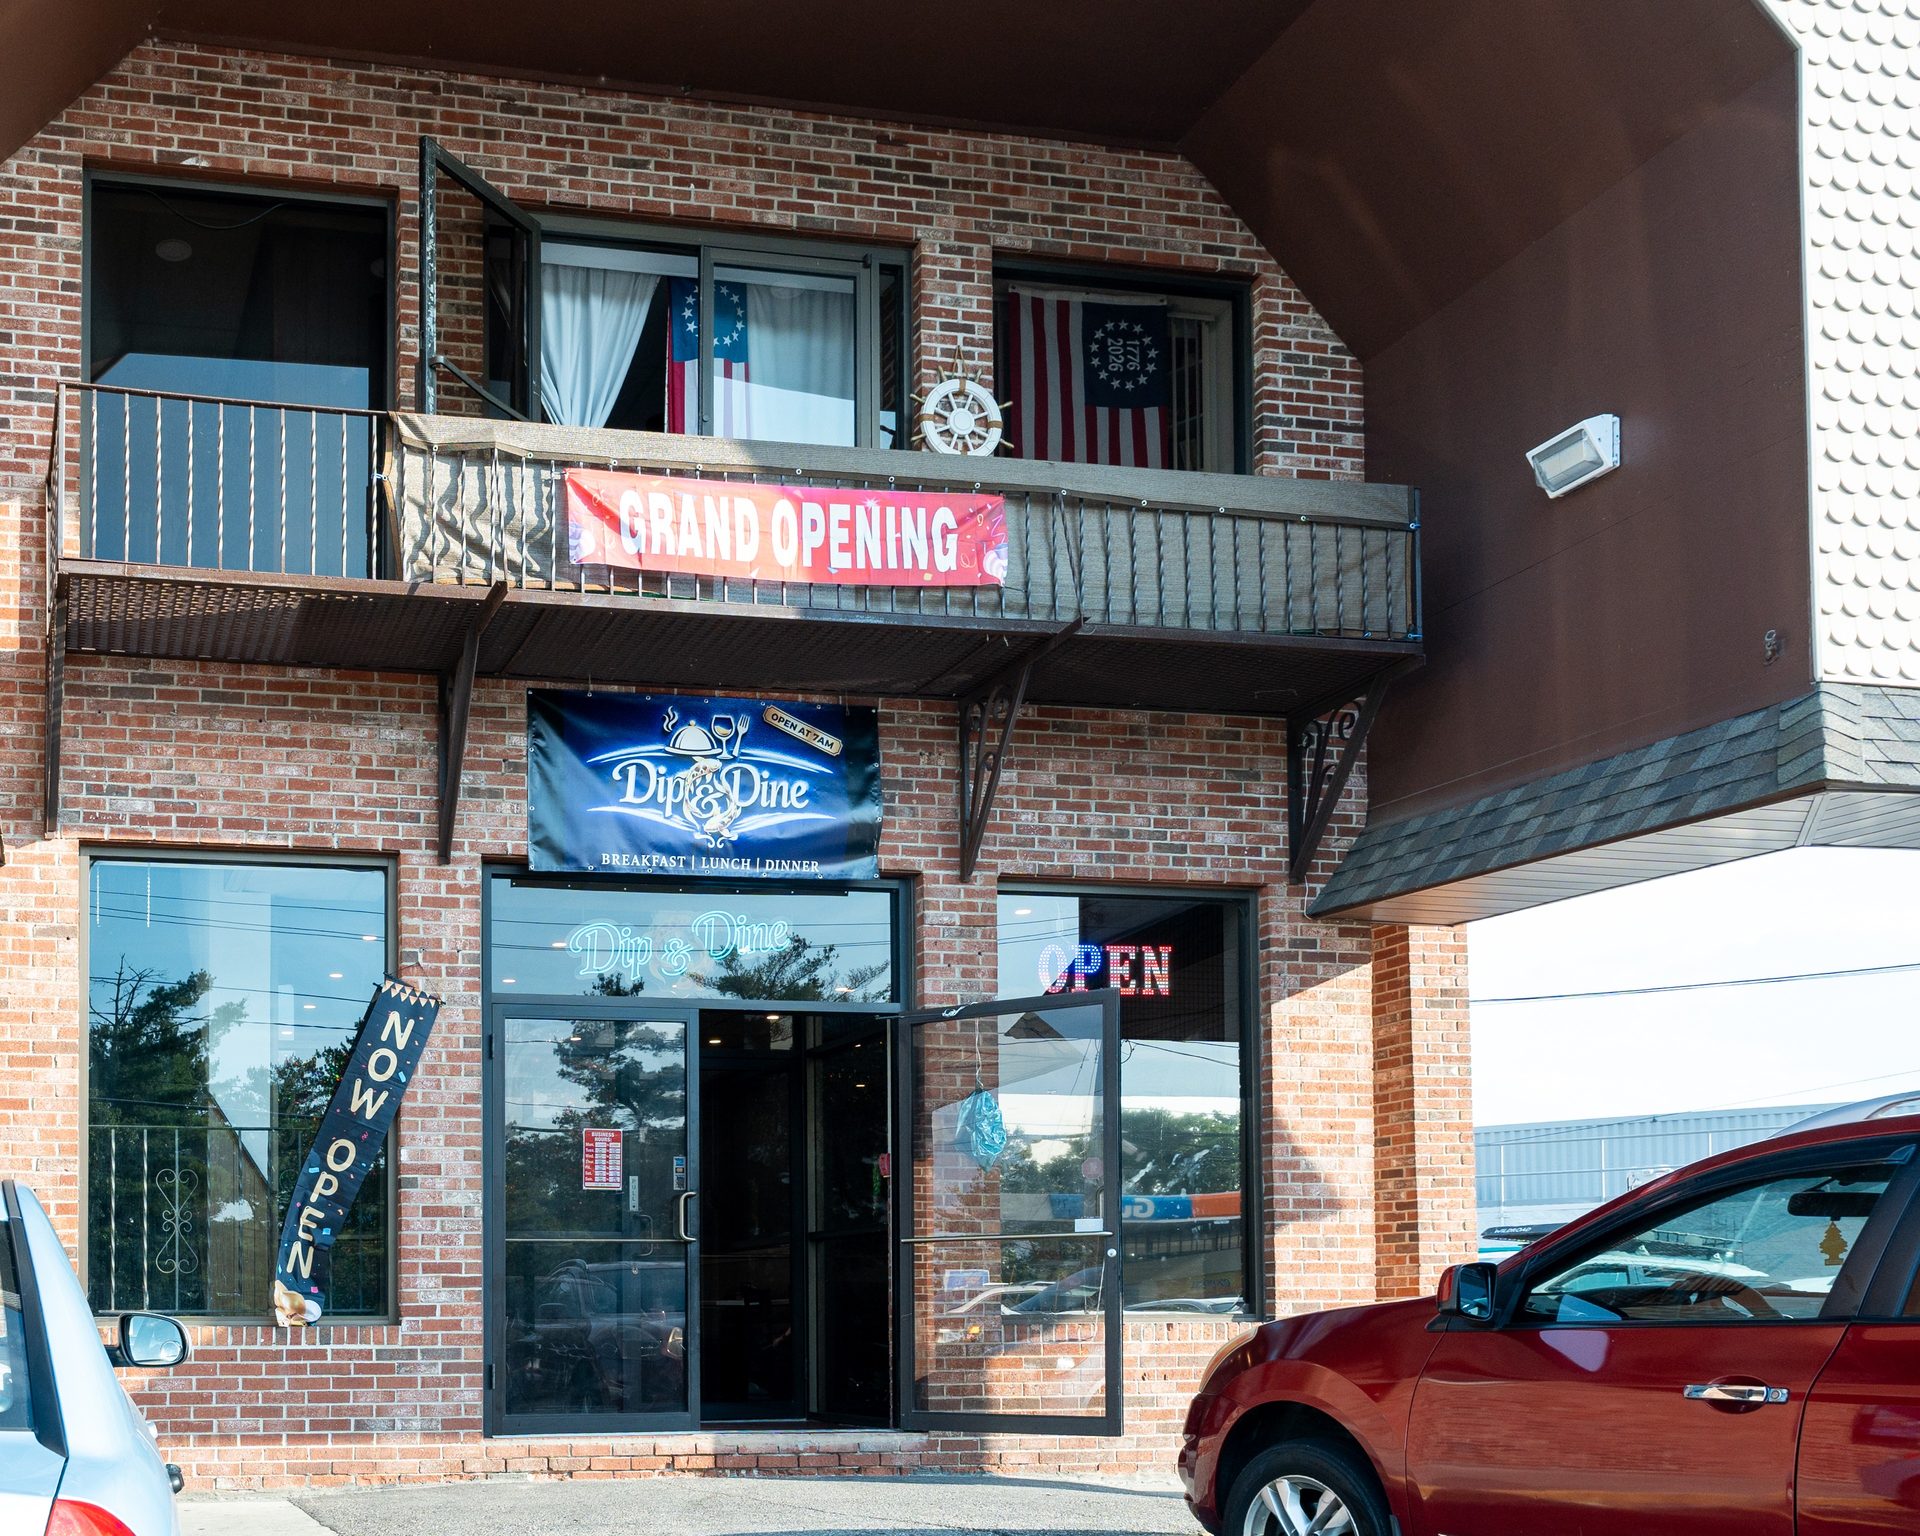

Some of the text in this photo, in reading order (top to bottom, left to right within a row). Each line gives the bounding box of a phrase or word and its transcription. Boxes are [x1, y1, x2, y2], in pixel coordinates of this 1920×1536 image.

[1108, 338, 1124, 372] 2026
[1126, 339, 1140, 371] 1776
[619, 489, 959, 573] GRAND OPENING
[771, 713, 834, 749] OPEN AT 7AM
[612, 758, 686, 818] Dip
[719, 763, 810, 809] Dine
[602, 853, 687, 869] BREAKFAST
[701, 856, 752, 871] LUNCH
[765, 859, 820, 873] DINNER
[569, 910, 791, 981] Dip & Dine
[1038, 943, 1172, 996] OPEN
[351, 1010, 415, 1120] NOW
[286, 1138, 356, 1279] OPEN
